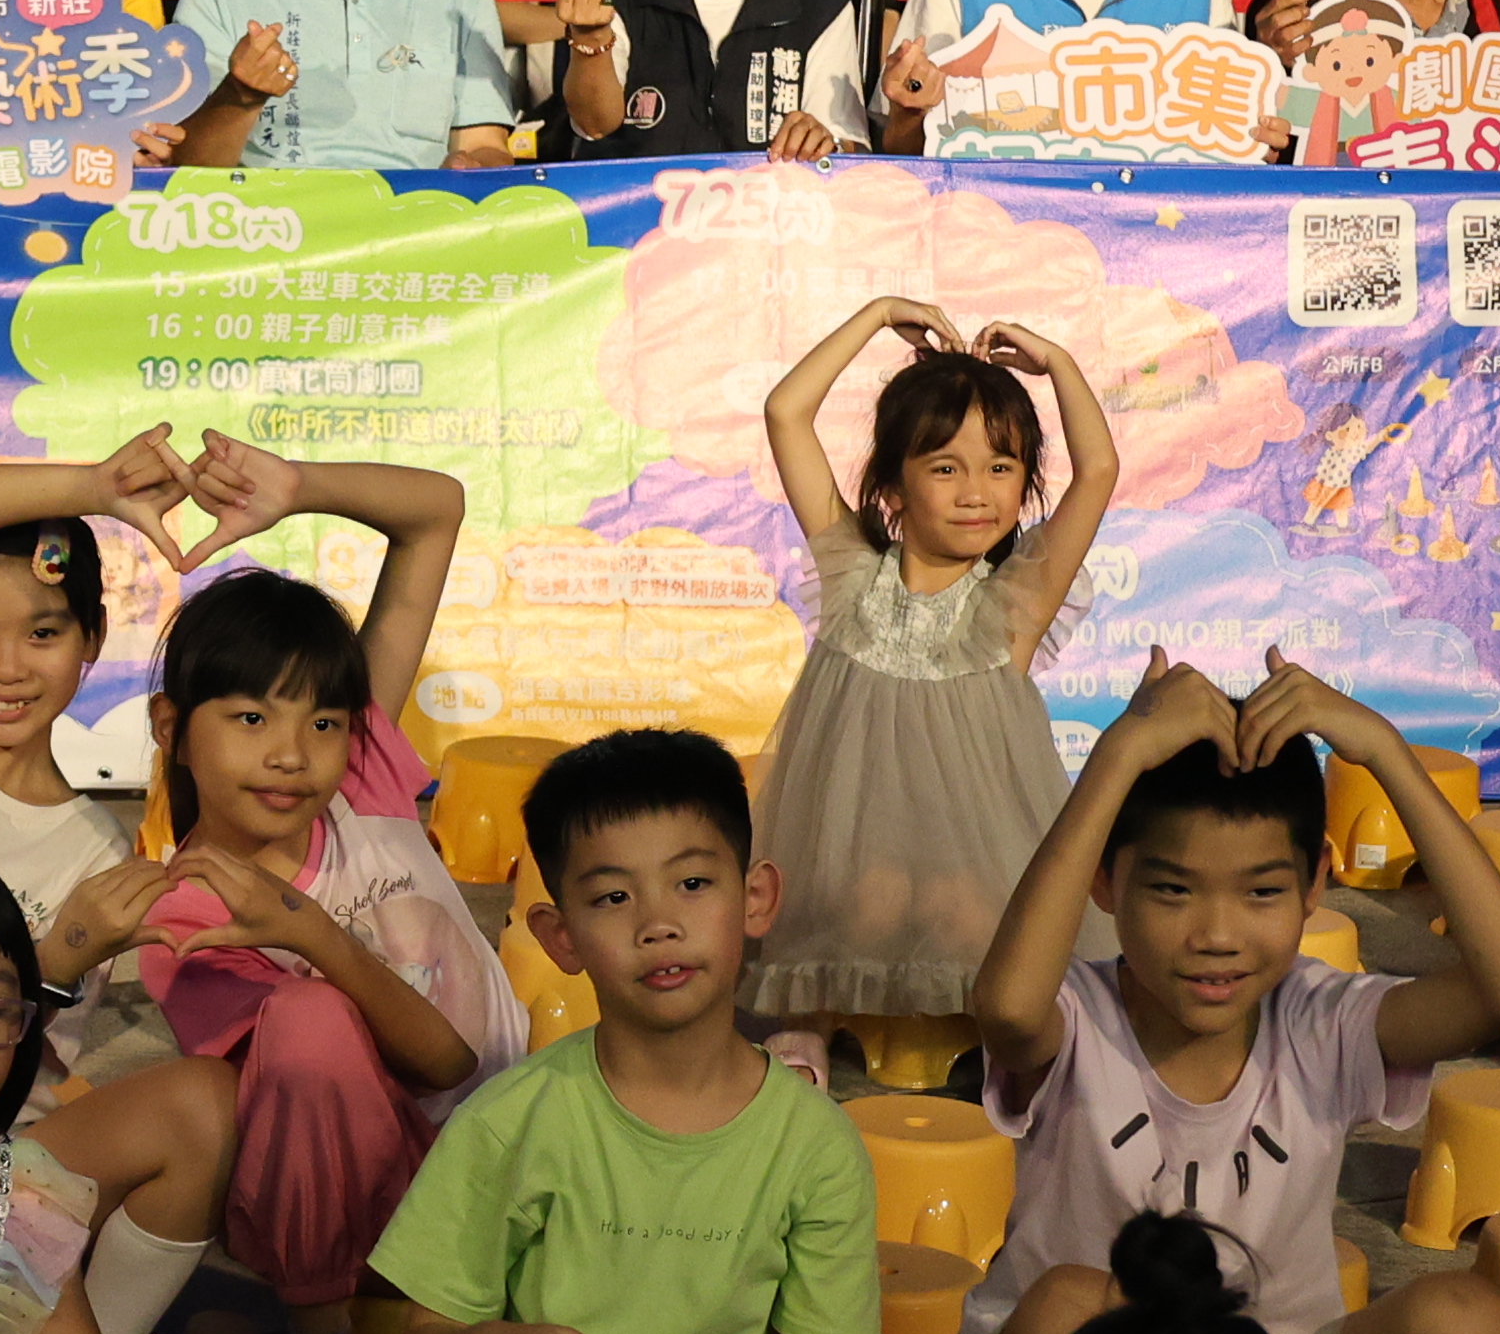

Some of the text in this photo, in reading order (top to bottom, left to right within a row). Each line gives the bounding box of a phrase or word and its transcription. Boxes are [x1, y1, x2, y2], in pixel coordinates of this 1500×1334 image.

[1064, 46, 1257, 142] 市集
[266, 271, 551, 303] 大型車交通安全宣導
[260, 311, 453, 345] 親子創意市集
[256, 358, 422, 396] 萬花筒劇團
[1321, 355, 1384, 374] 公所FB
[702, 1227, 733, 1242] day
